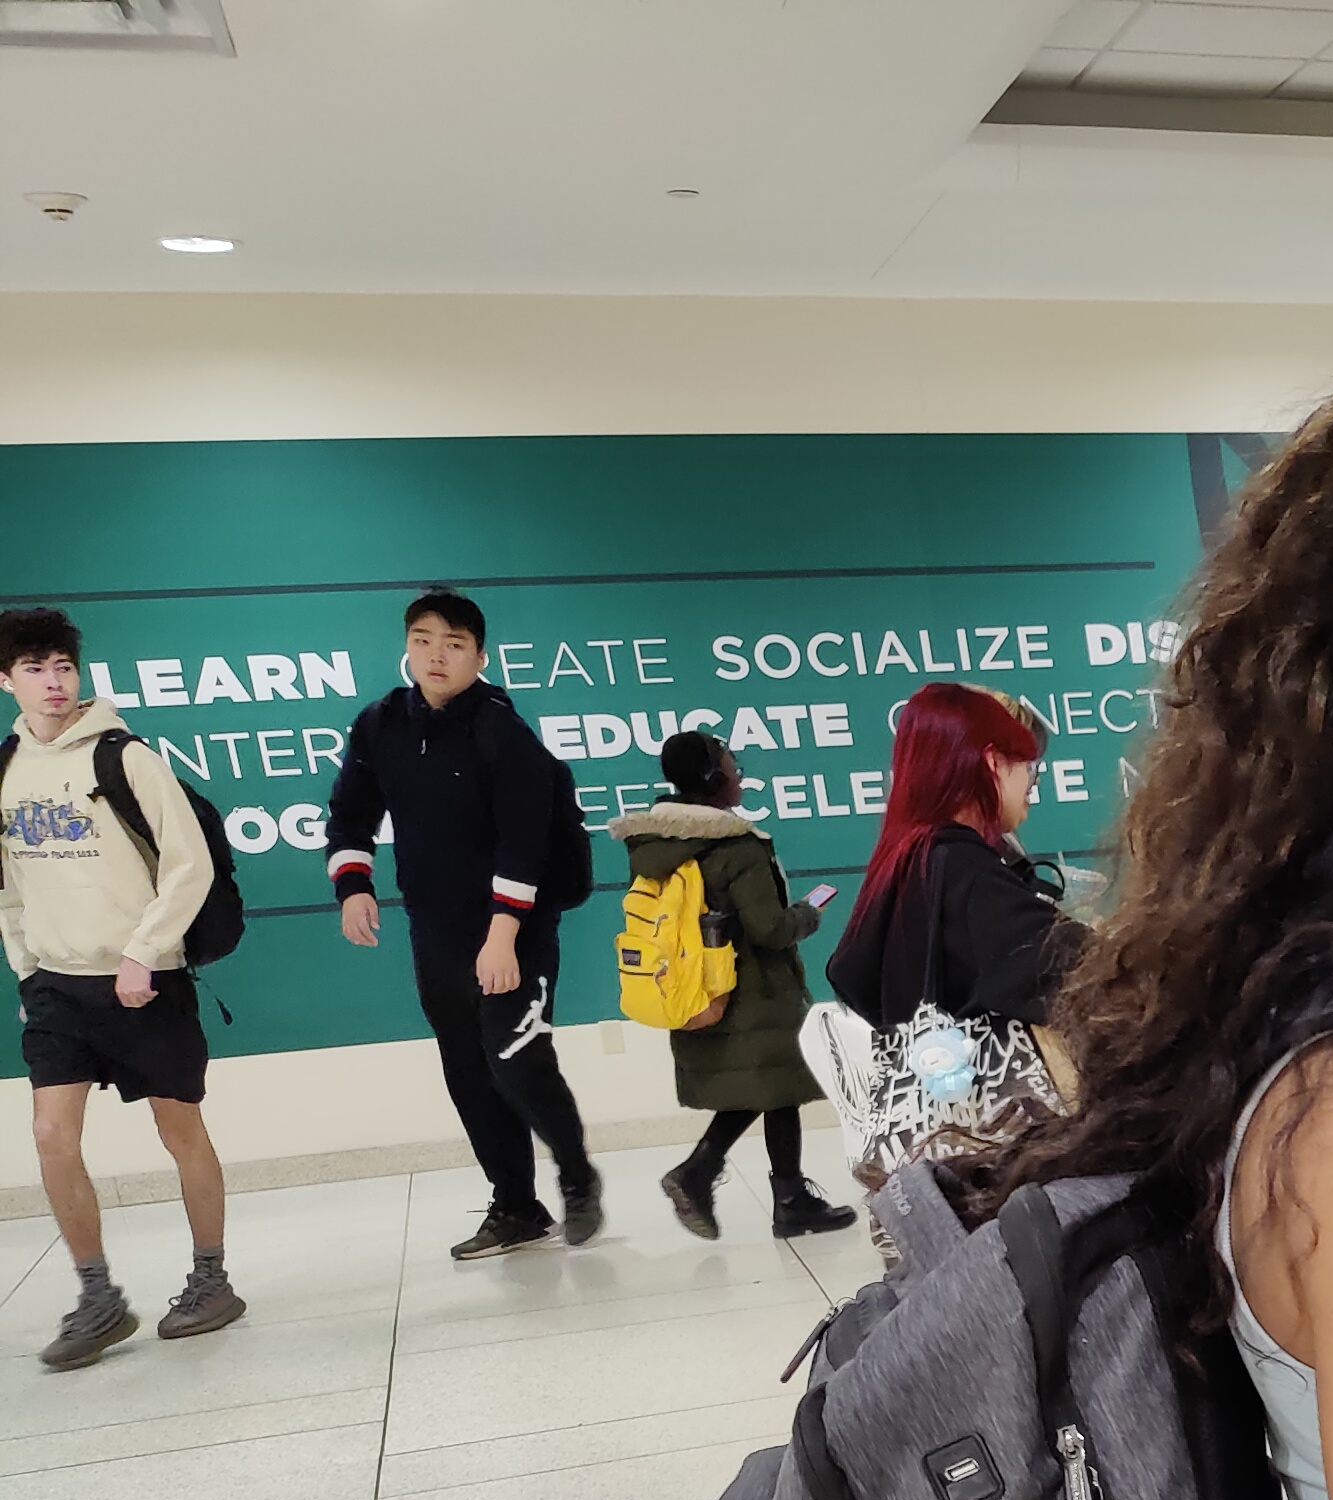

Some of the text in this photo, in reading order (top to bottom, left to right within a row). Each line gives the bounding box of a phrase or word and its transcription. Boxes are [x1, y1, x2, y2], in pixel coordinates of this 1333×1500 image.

[89, 650, 357, 709] LEARN
[712, 624, 1054, 681] SOCIALIZE
[1084, 621, 1183, 666] DIS
[142, 728, 352, 781] NTER
